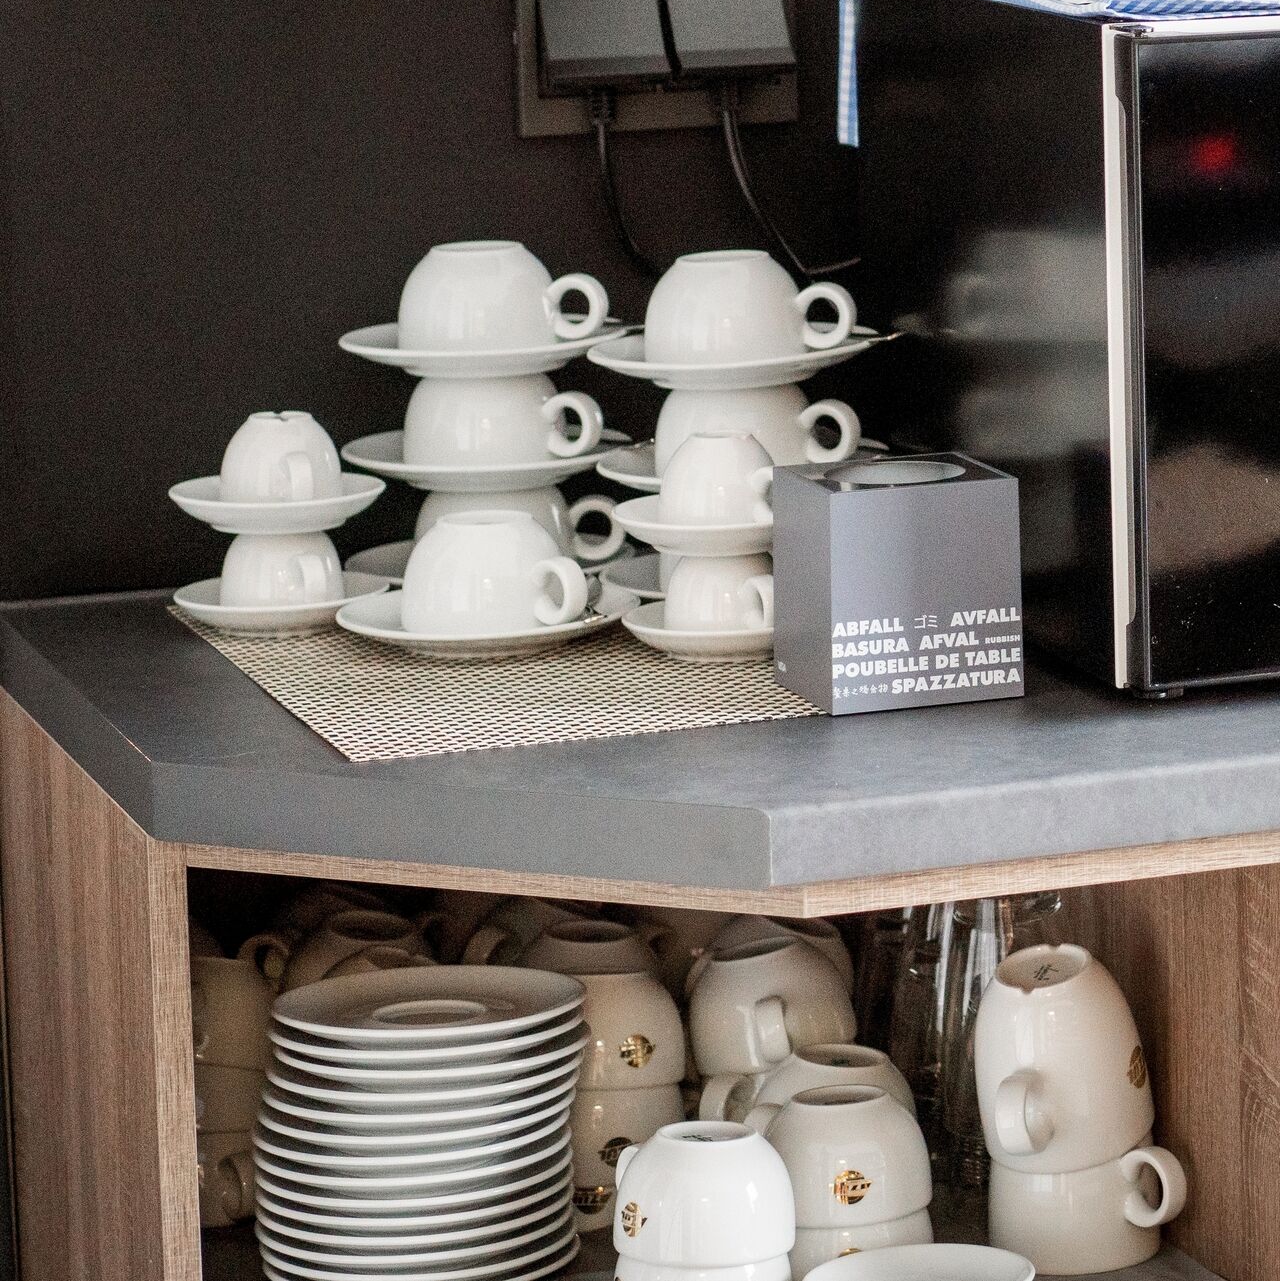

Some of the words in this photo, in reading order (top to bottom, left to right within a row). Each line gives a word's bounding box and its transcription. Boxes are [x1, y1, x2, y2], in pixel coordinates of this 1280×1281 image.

[832, 617, 904, 638] ABFALL
[914, 614, 938, 629] ゴミ
[950, 607, 1021, 627] AVFALL
[831, 637, 910, 659] BASURA
[919, 631, 979, 651] AFVAL
[984, 634, 1021, 644] RUBBISH
[832, 656, 929, 679] POUBELLE
[935, 653, 960, 669] DE
[965, 647, 1021, 667] TABLE
[891, 668, 1021, 694] SPAZZATURA
